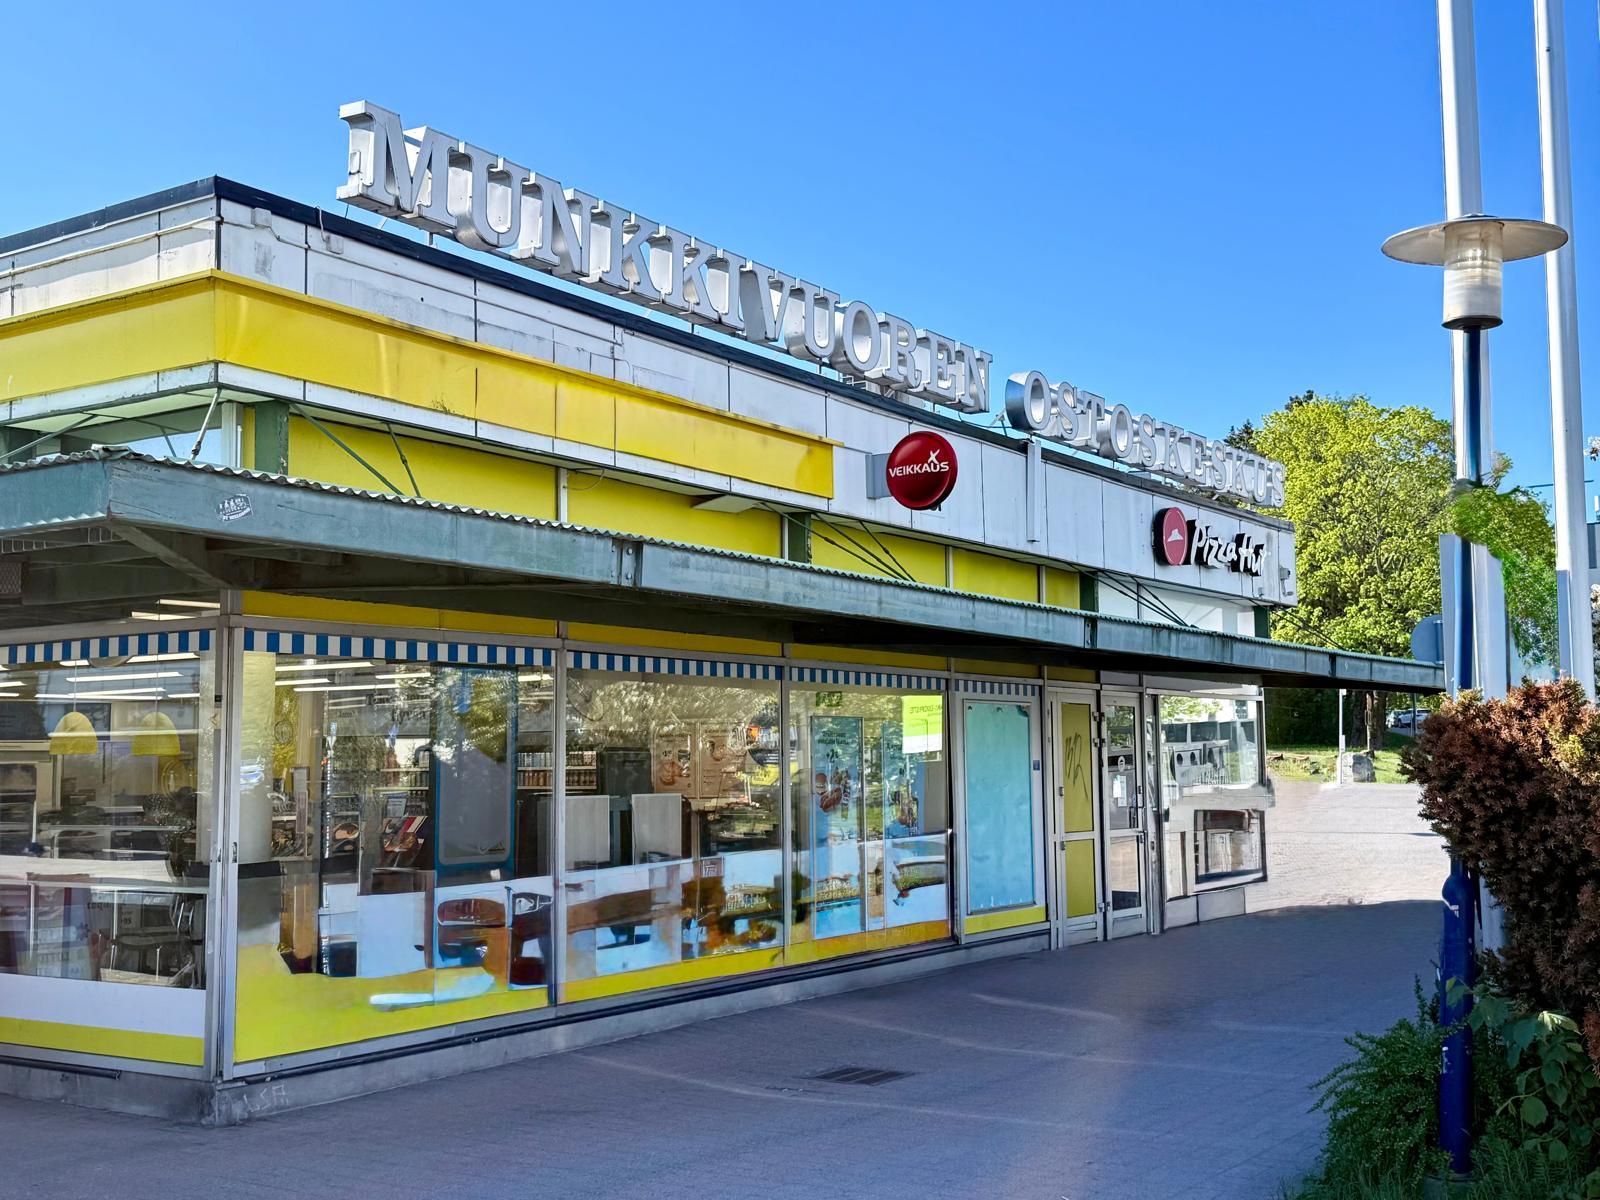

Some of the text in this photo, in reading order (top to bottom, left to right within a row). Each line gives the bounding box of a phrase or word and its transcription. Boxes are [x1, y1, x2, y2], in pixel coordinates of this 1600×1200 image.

[337, 99, 1286, 508] MUNKKIVUOREN OSTOSKESKUS
[888, 460, 950, 478] VEIKKAUS
[1190, 519, 1270, 577] Pizza Hut
